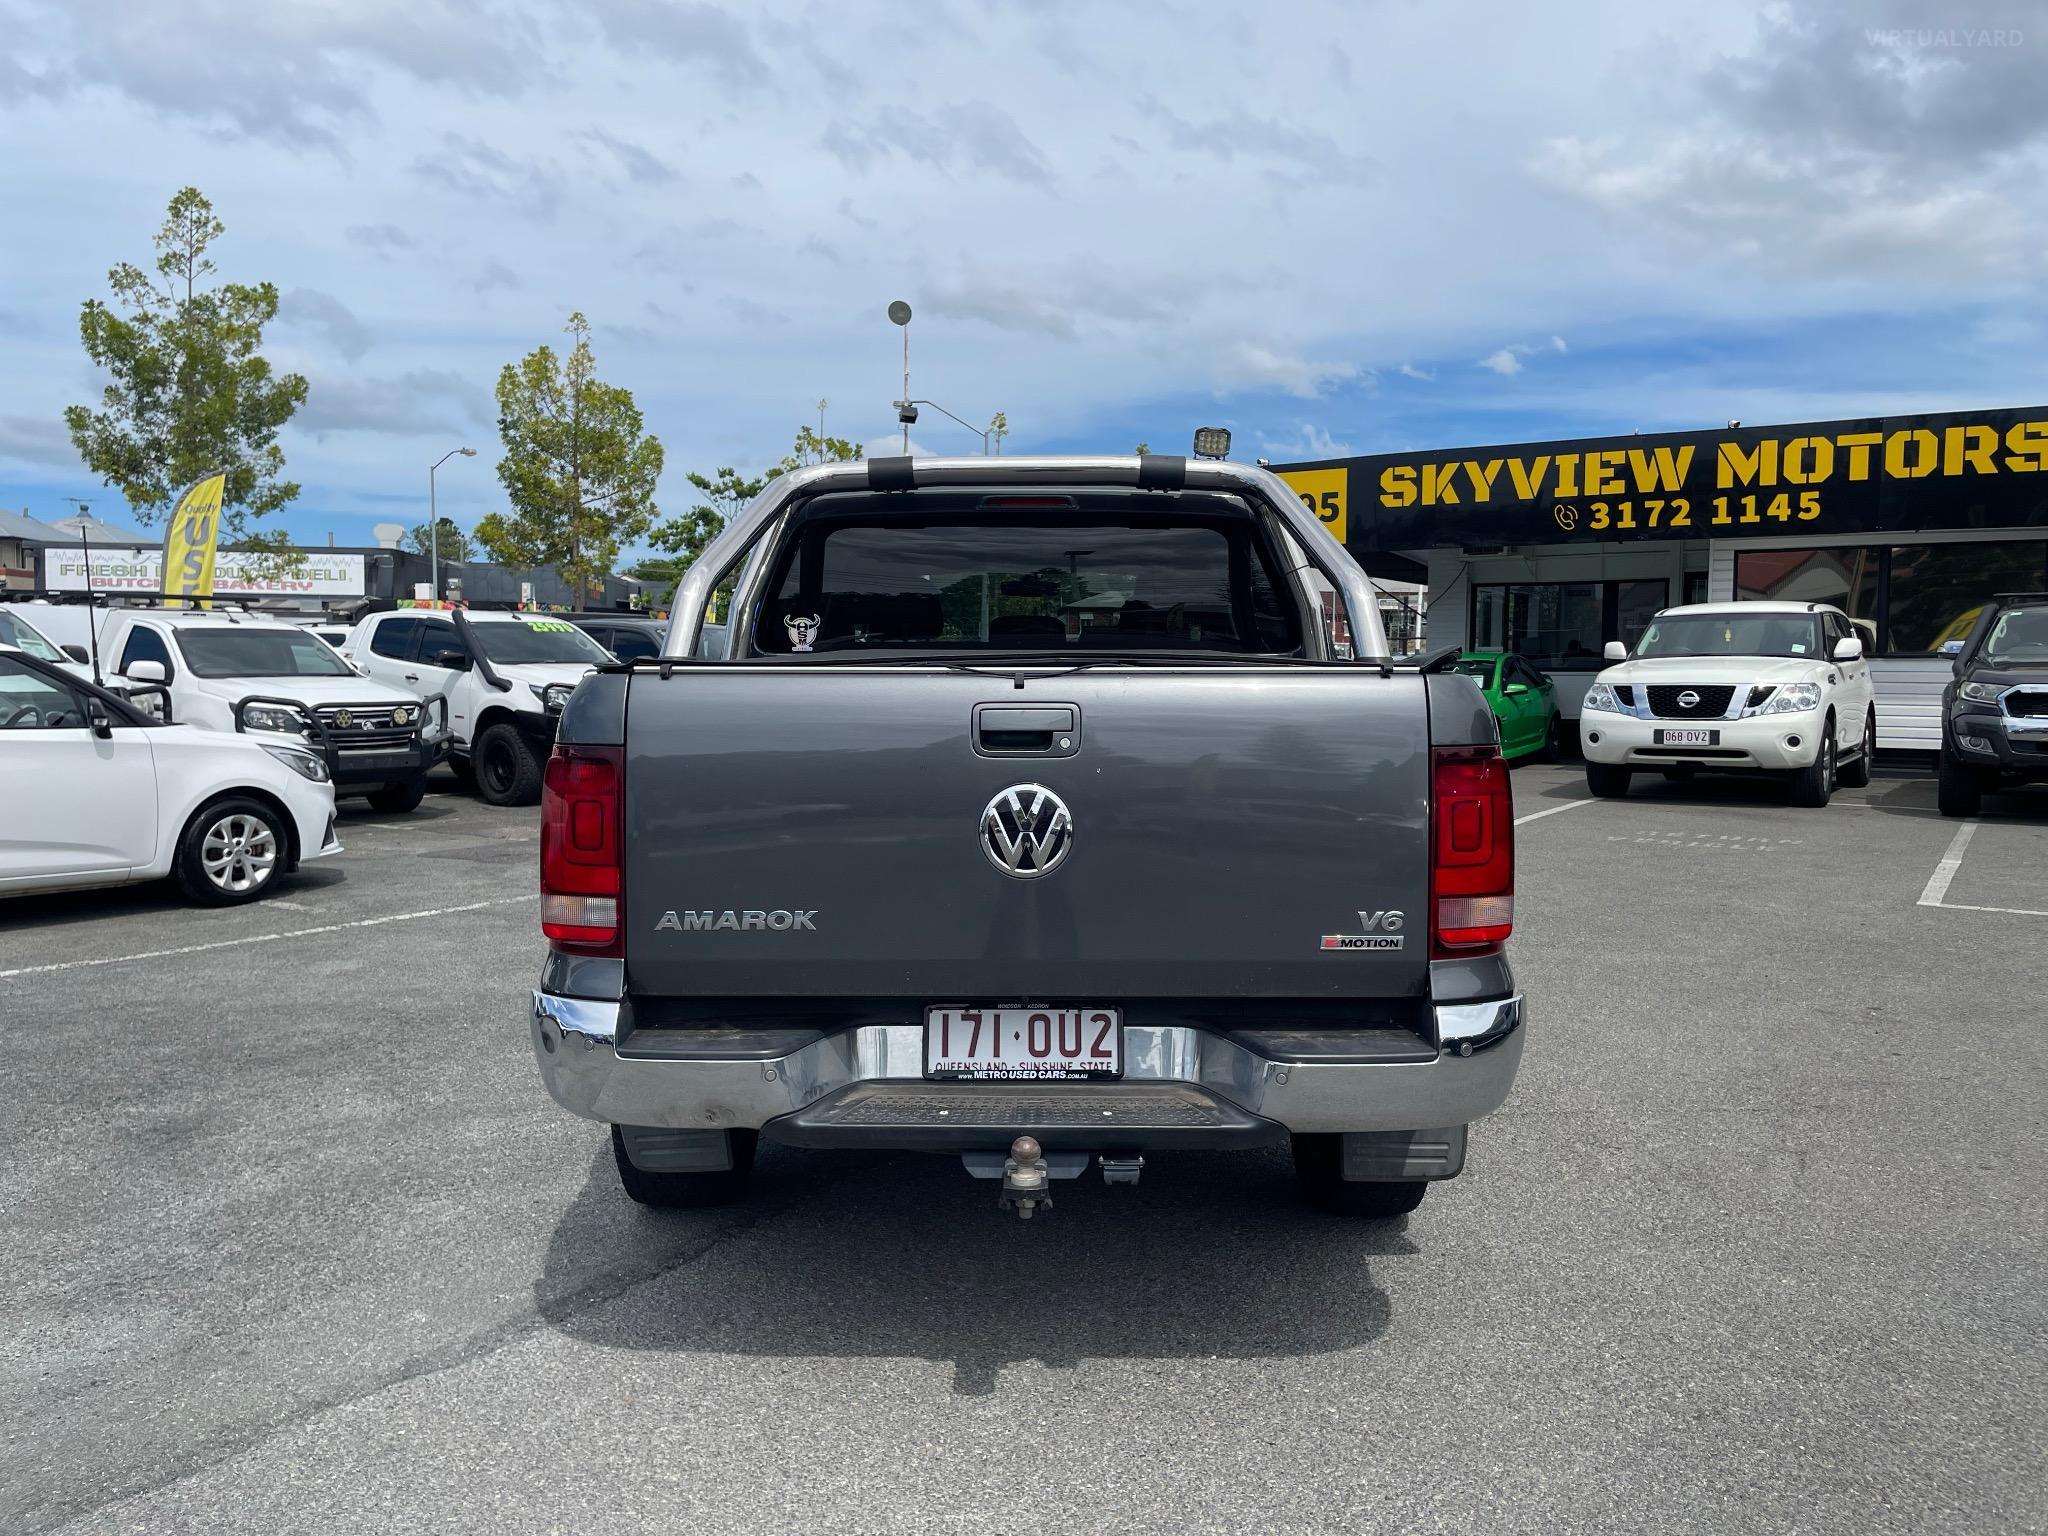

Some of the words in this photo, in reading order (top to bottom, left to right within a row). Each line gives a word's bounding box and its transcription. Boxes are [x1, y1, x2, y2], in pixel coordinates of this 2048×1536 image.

[1379, 446, 1696, 508] SKYVIEW
[1717, 421, 2048, 489] MOTORS
[1590, 499, 1692, 530] 3172
[1711, 491, 1821, 525] 1145
[60, 564, 148, 577] FRESH
[213, 579, 313, 591] BAKERY
[654, 910, 819, 931] AMAROK
[1357, 910, 1405, 932] V6
[935, 1062, 1008, 1070] QUEENSLAND
[1019, 1062, 1074, 1070] SUNSHINE
[1079, 1062, 1112, 1070] STATE
